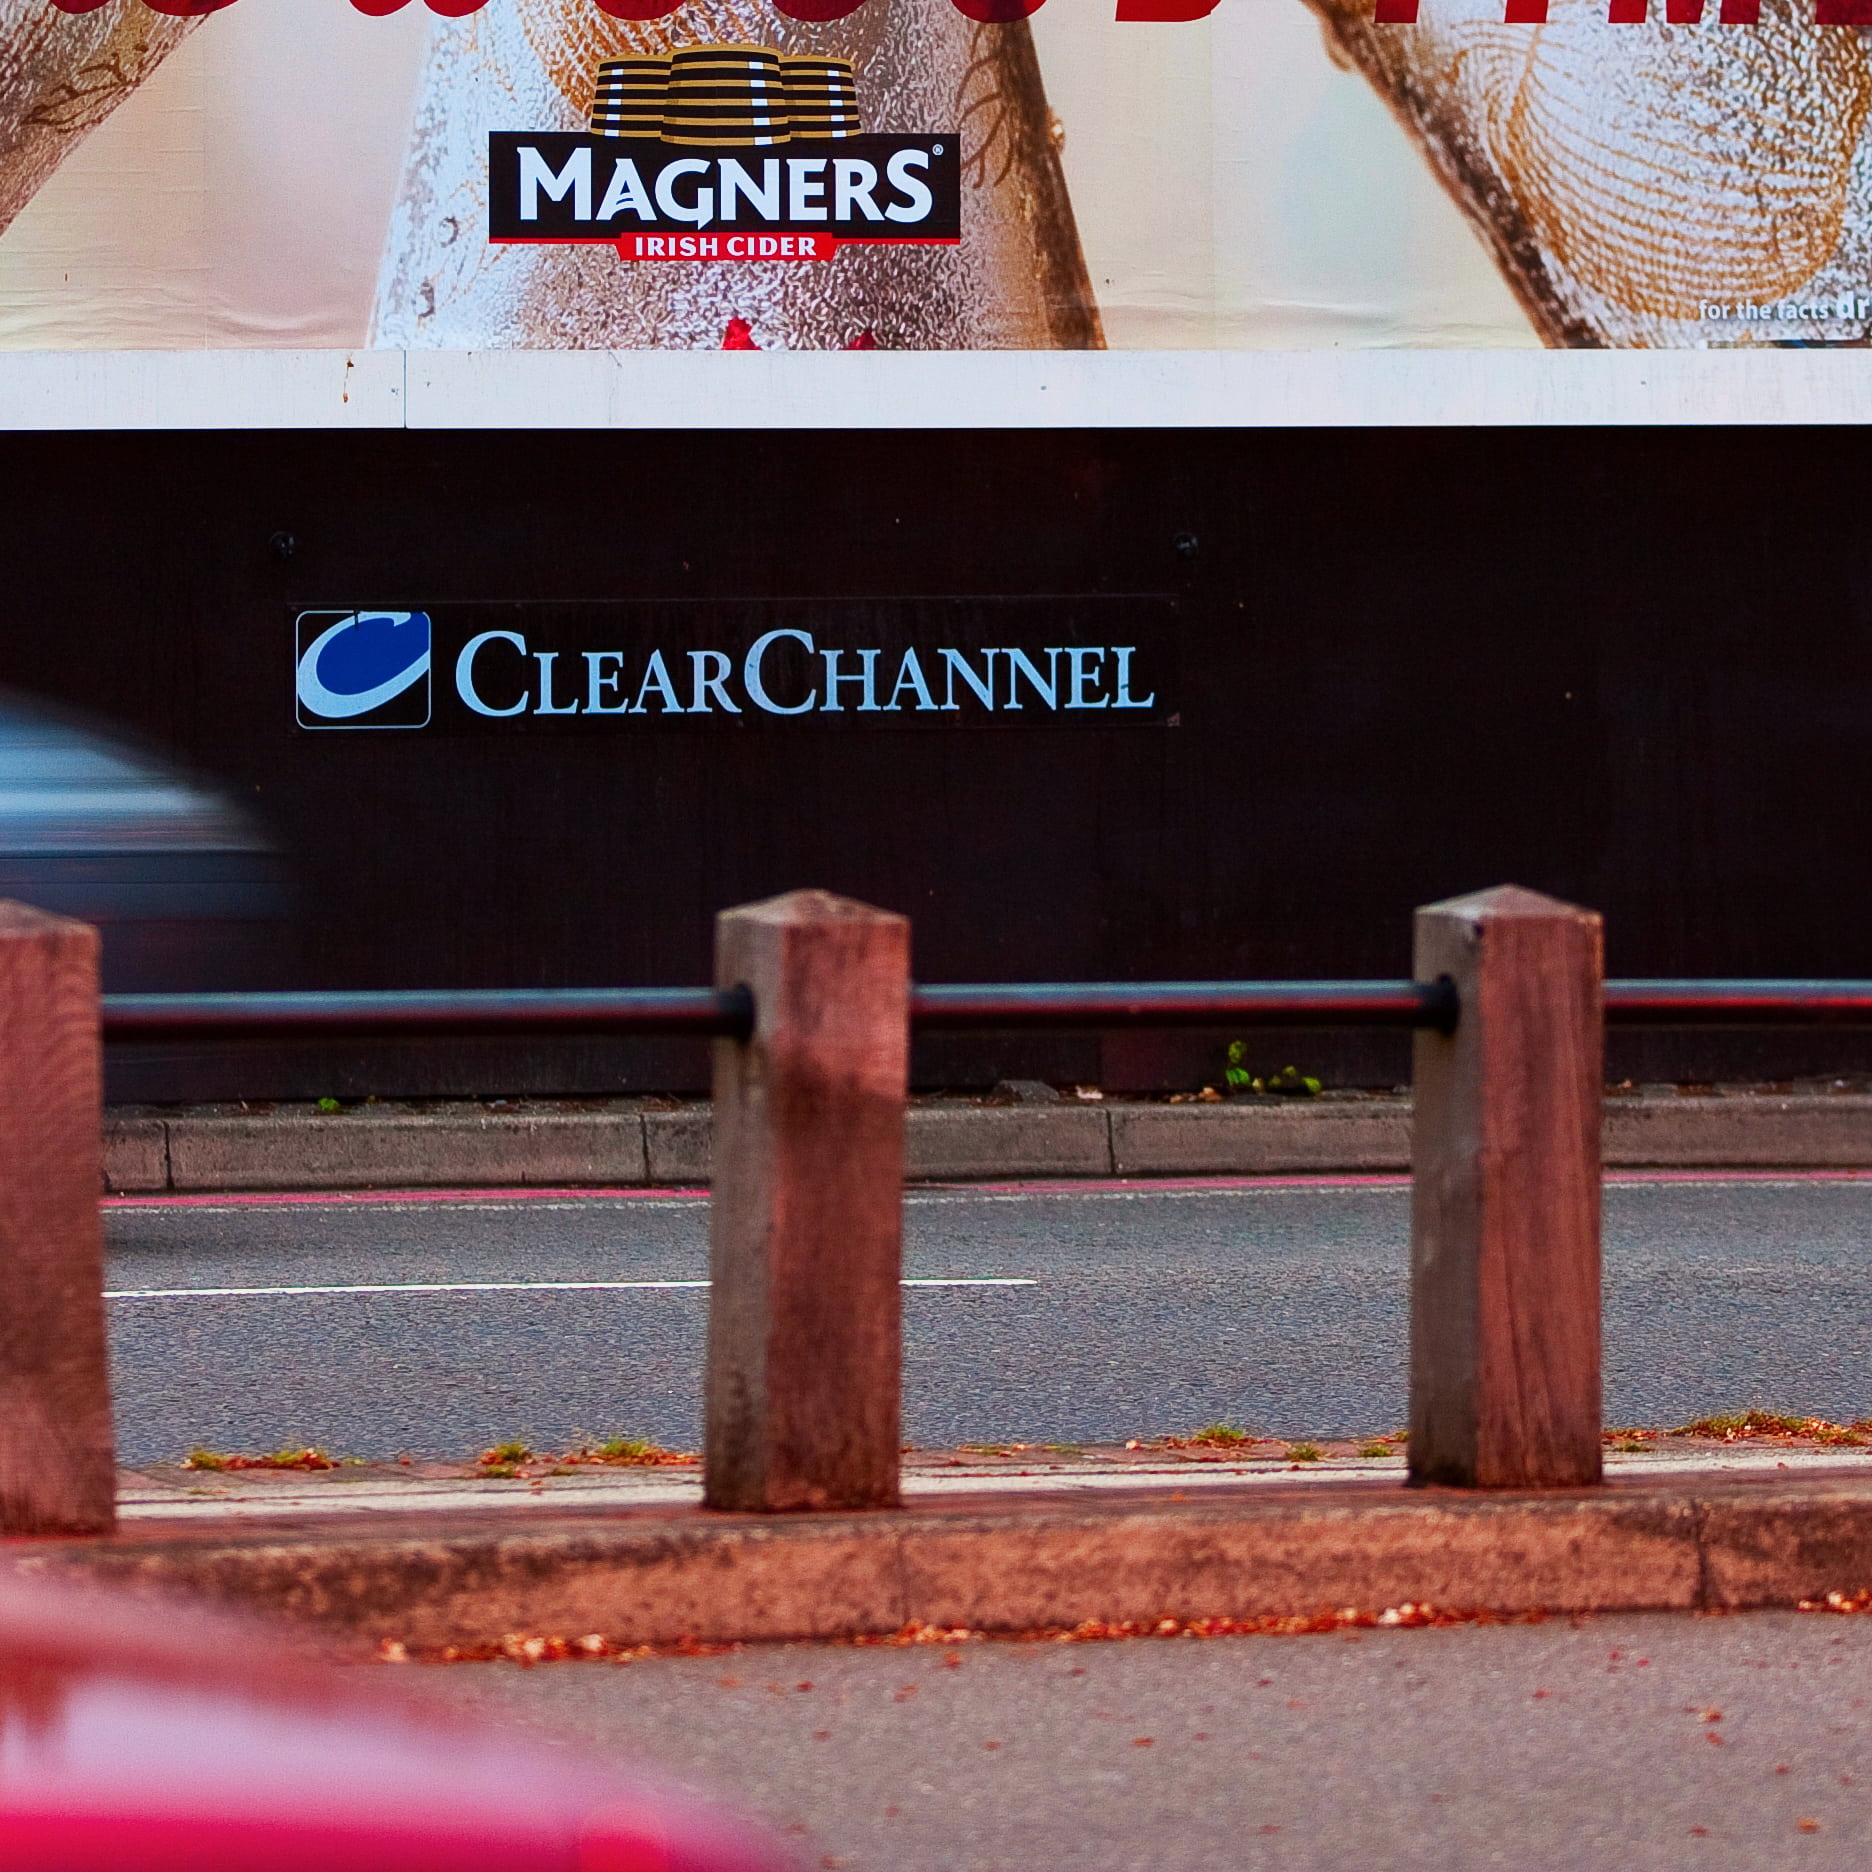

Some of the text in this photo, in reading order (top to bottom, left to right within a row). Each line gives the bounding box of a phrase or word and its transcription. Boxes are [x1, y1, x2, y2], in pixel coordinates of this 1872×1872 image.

[634, 235, 817, 257] IRISH CIDER
[1698, 300, 1730, 321] for
[1736, 299, 1770, 321] the
[1777, 299, 1830, 321] facts
